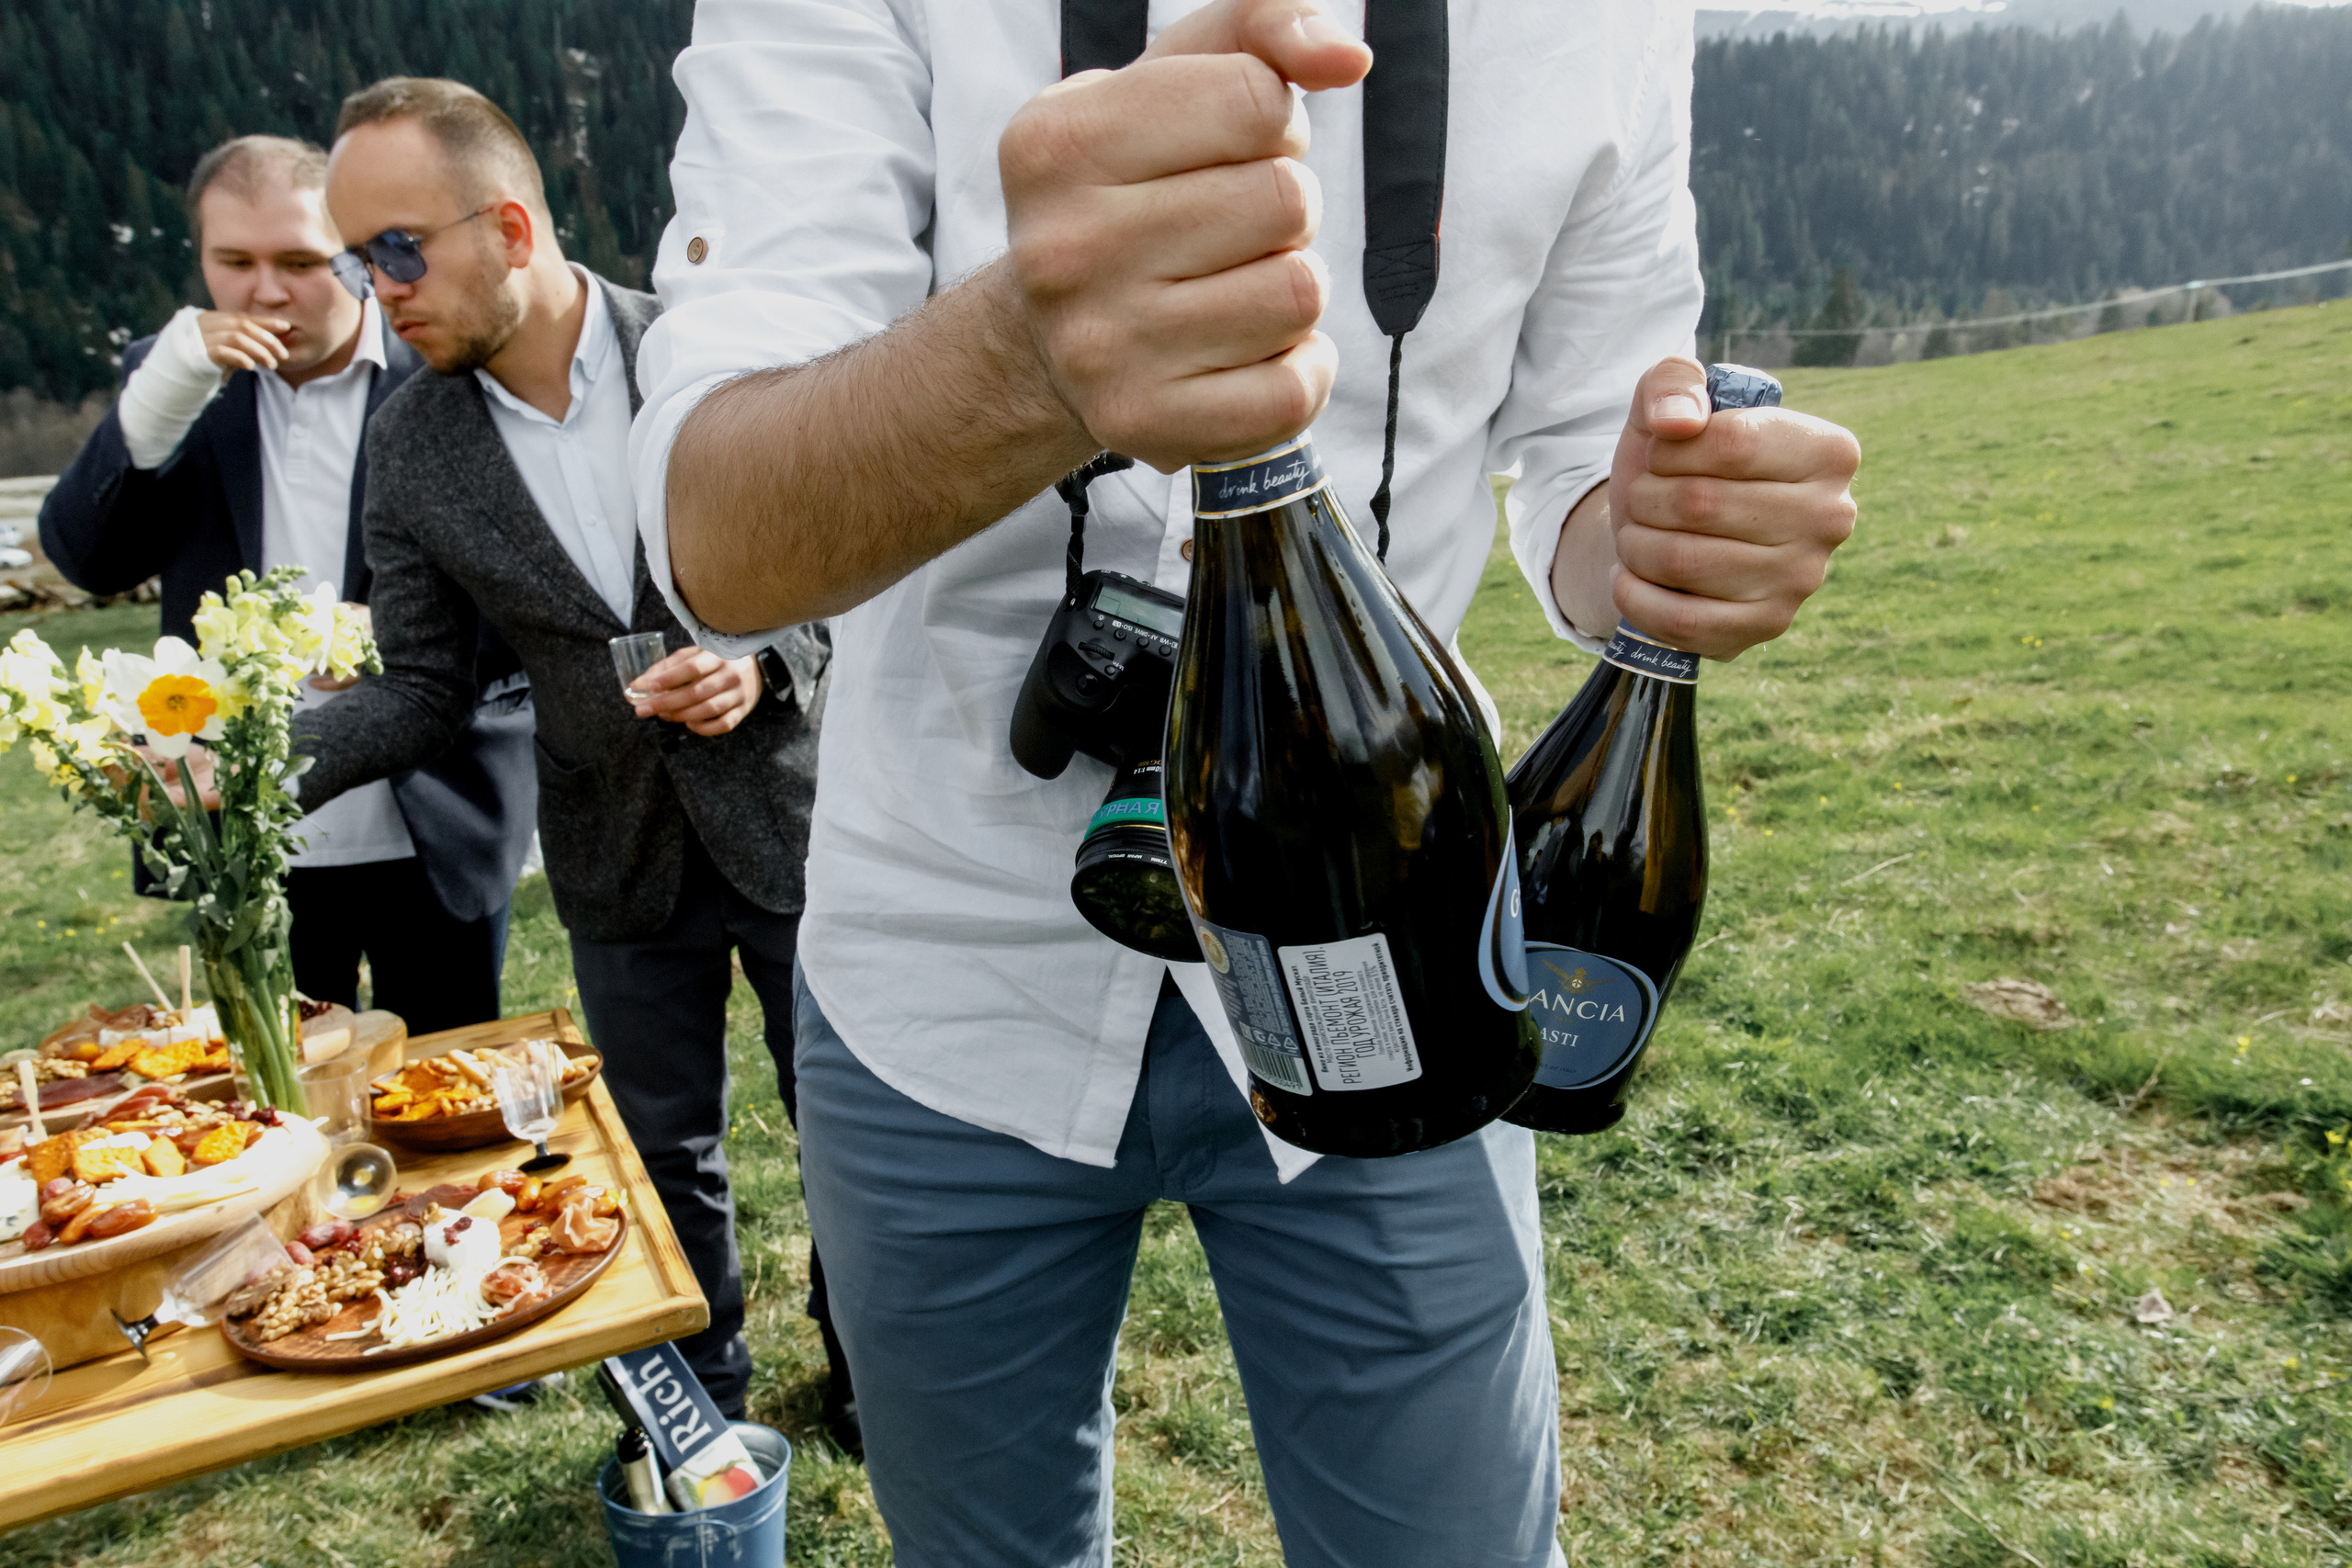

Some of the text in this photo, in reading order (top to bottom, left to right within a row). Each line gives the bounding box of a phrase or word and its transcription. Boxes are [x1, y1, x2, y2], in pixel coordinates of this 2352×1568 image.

[1219, 470, 1259, 499] drink
[1263, 459, 1310, 491] beauty
[1631, 646, 1662, 666] drink
[1661, 654, 1692, 677] beauty
[1093, 801, 1159, 821] УРНАЯ
[1301, 946, 1362, 1085] РЕГИОН ПЬЕМОНТ (ИТАЛИЯ).
[1331, 969, 1379, 1058] ГОД УРОЖАЯ 2019
[1530, 988, 1625, 1022] ANCIA
[1540, 1027, 1579, 1047] ASTI
[638, 1353, 713, 1455] Rich
